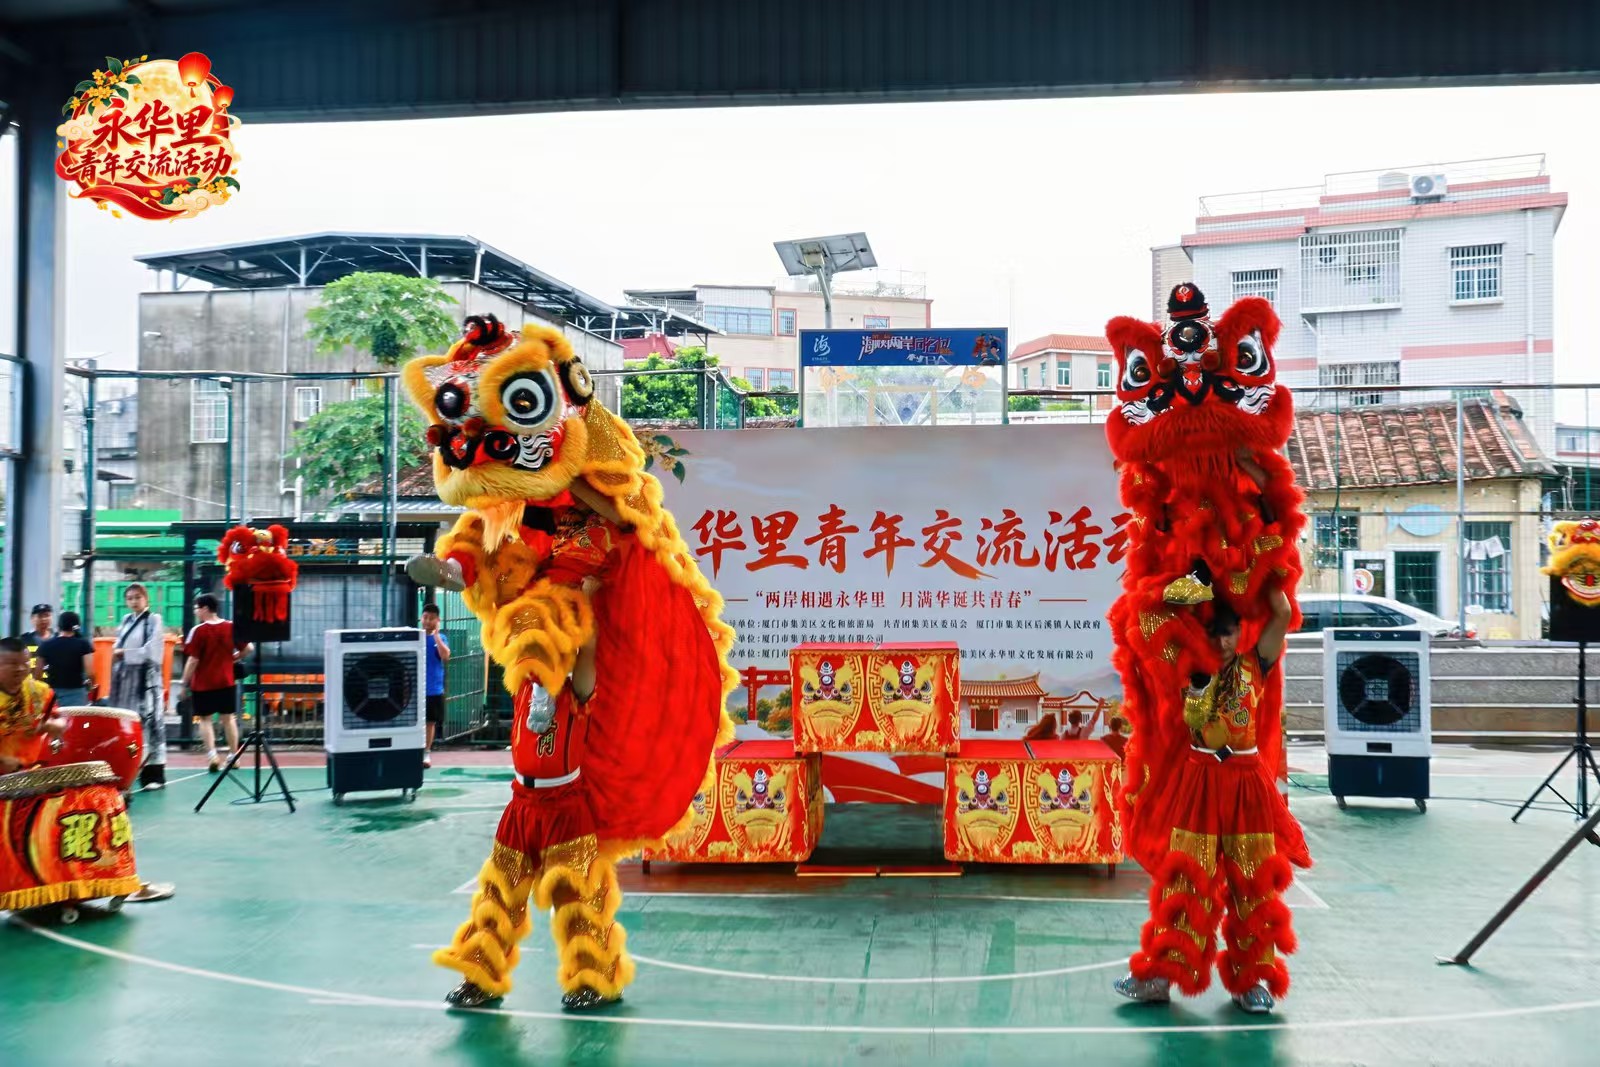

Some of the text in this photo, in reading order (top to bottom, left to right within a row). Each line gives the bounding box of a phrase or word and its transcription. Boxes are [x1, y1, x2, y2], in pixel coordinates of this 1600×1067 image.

[883, 619, 968, 629] 共青团集美区委员会
[976, 619, 1101, 630] 厦门市集美区后溪镇人民政府
